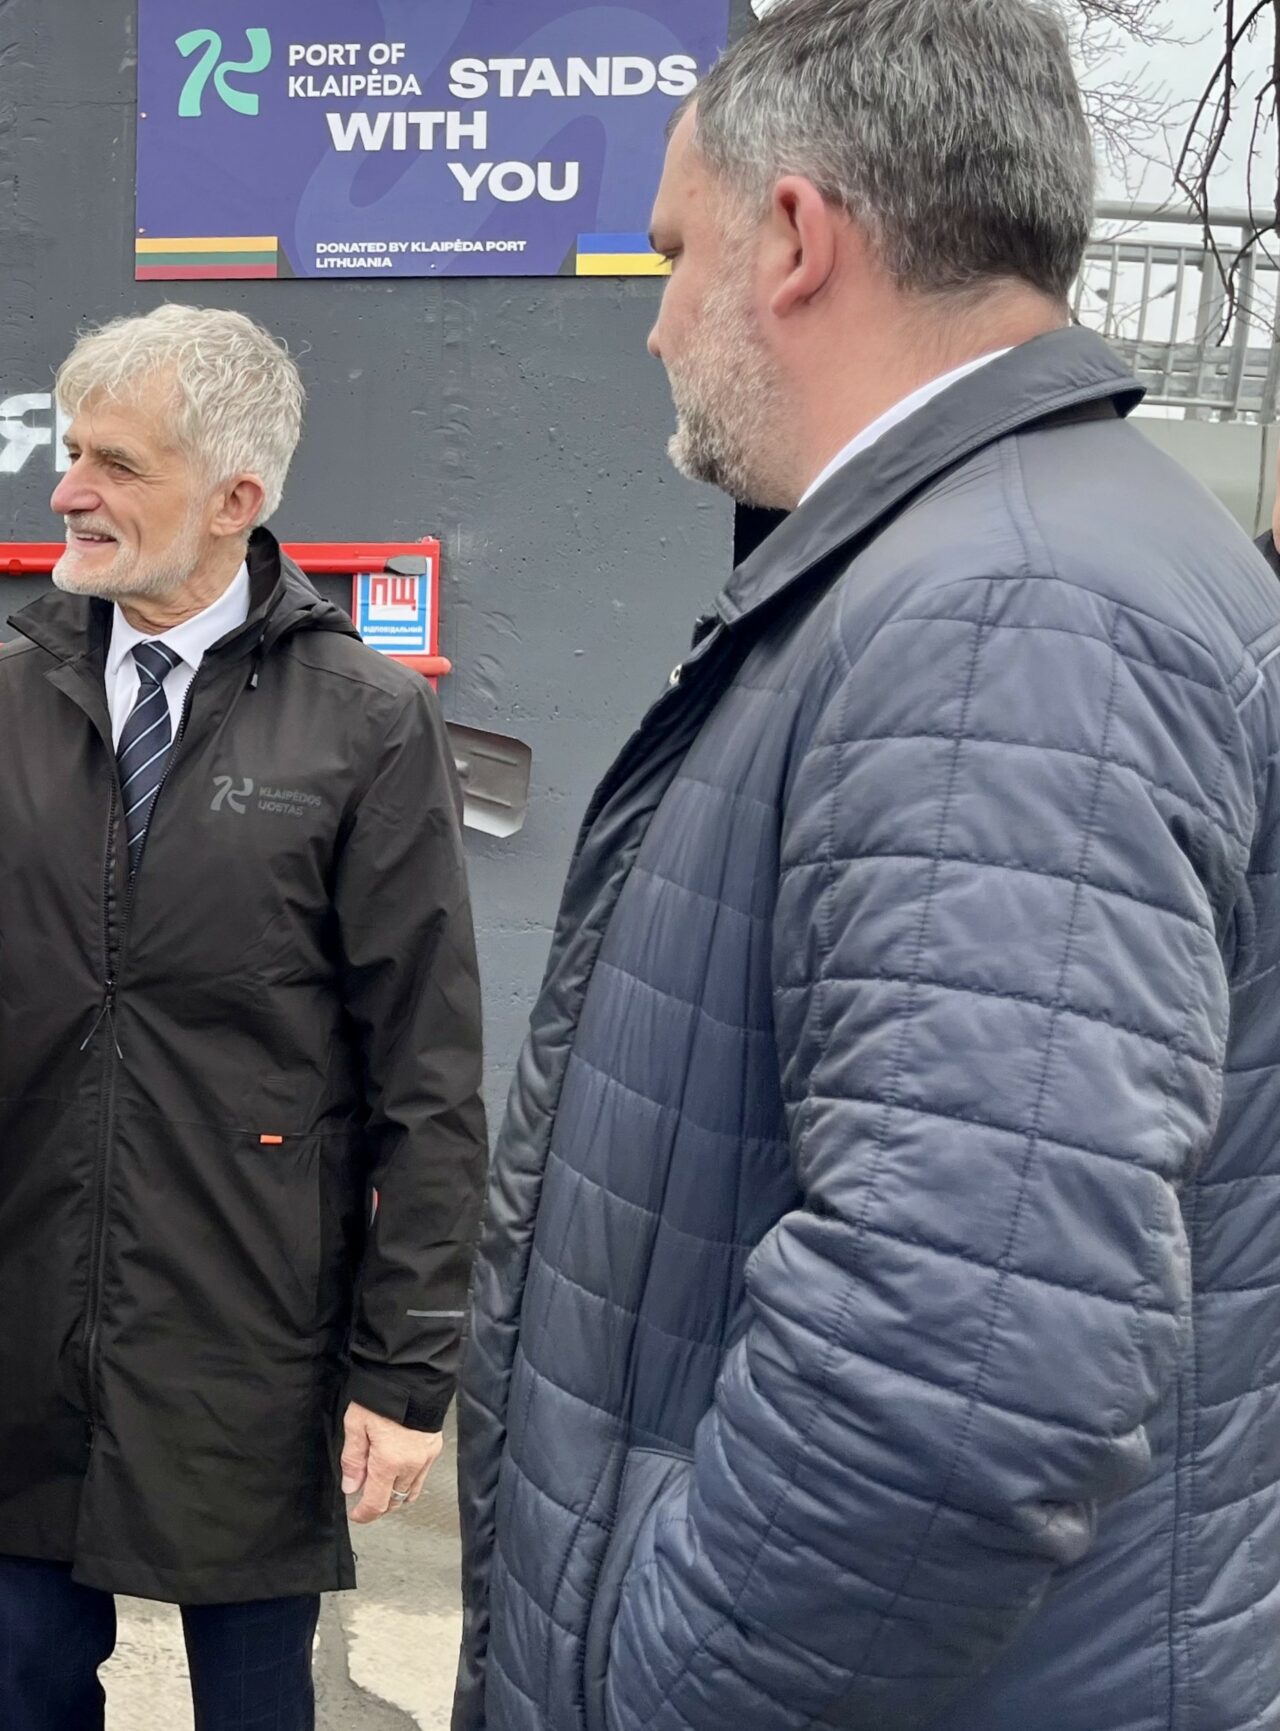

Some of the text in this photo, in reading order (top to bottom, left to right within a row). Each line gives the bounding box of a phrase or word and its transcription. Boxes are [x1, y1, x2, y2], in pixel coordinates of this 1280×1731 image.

[288, 42, 406, 67] PORT OF
[288, 67, 422, 98] KLAIPĖDA
[448, 54, 698, 99] STANDS
[326, 110, 488, 152] WITH
[446, 160, 580, 203] YOU
[316, 238, 527, 254] DONATED BY KLAIPĖDA PORT
[316, 257, 393, 269] LITHUANIA
[371, 577, 417, 611] ПЩ
[258, 800, 304, 816] UOSTAS
